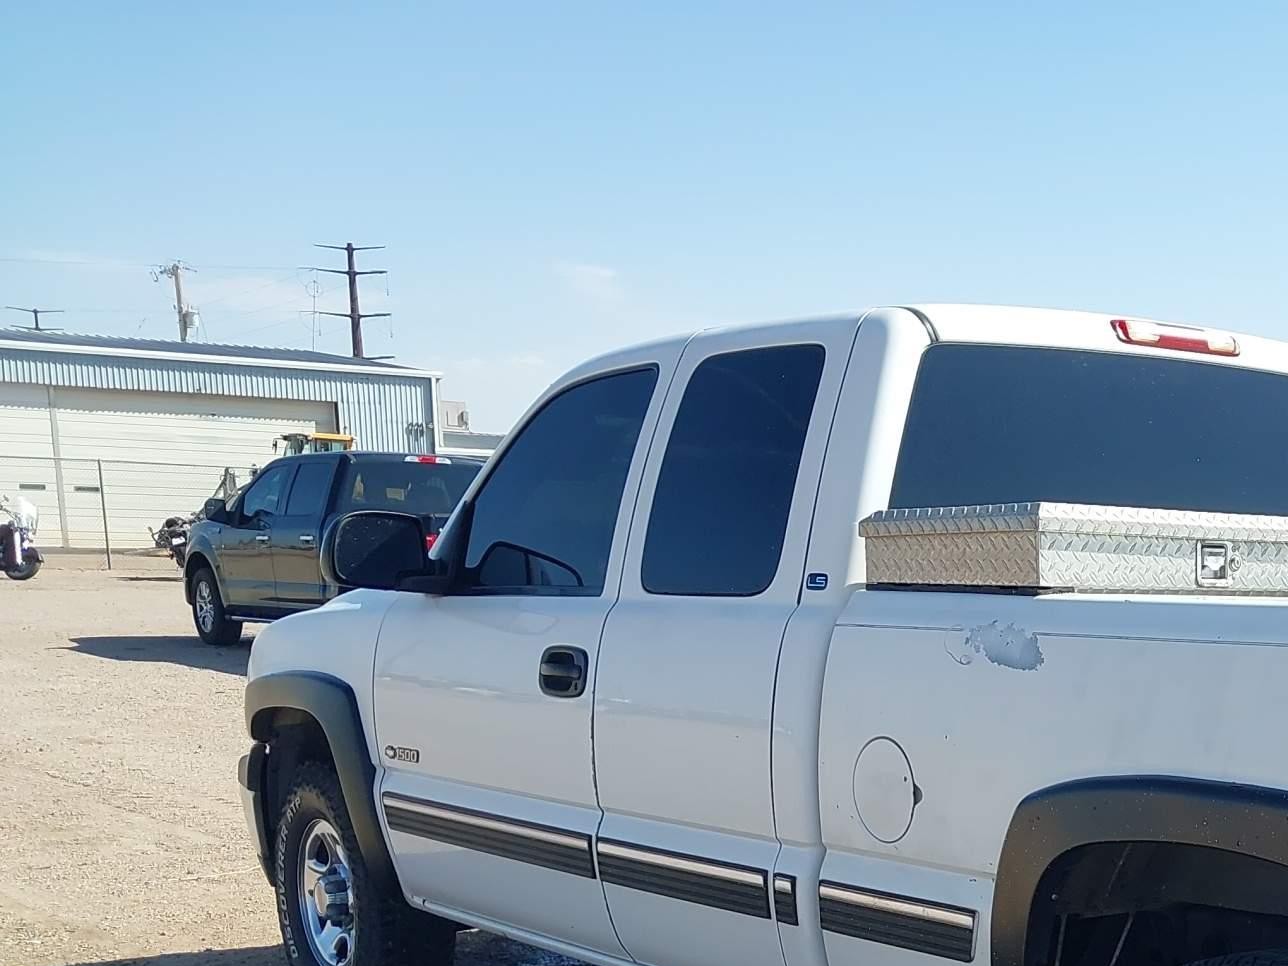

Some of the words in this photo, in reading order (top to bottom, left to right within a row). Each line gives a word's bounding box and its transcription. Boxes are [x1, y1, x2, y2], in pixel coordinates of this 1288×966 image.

[807, 576, 826, 587] LS
[396, 748, 418, 763] 1500
[277, 824, 299, 959] DISCOVERER
